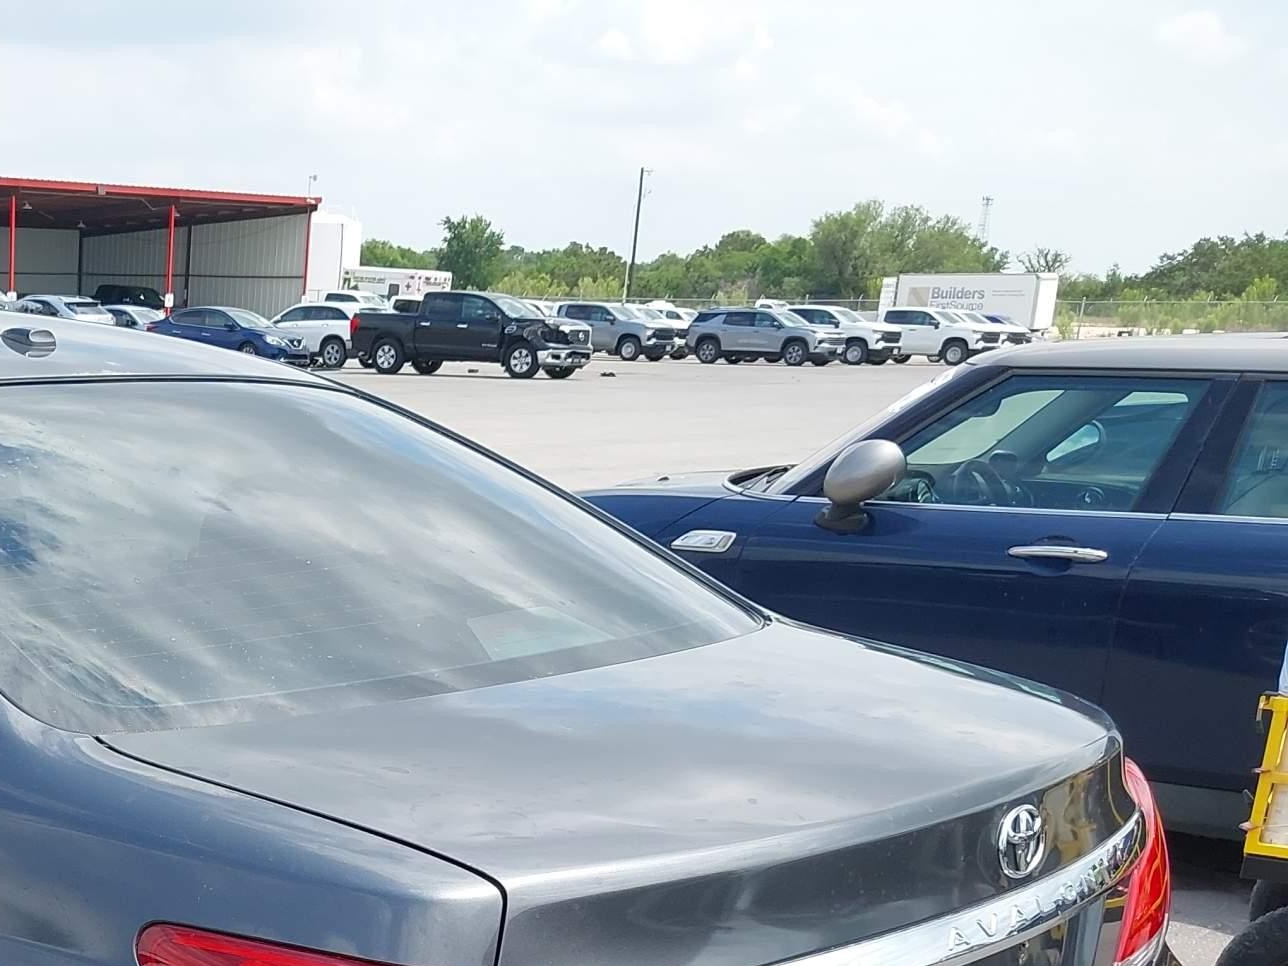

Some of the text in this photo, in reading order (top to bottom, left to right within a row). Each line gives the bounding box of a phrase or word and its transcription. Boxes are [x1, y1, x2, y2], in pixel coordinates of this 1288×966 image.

[930, 286, 985, 299] Builders
[929, 300, 984, 311] FirstSource
[946, 868, 1099, 952] AVALON
